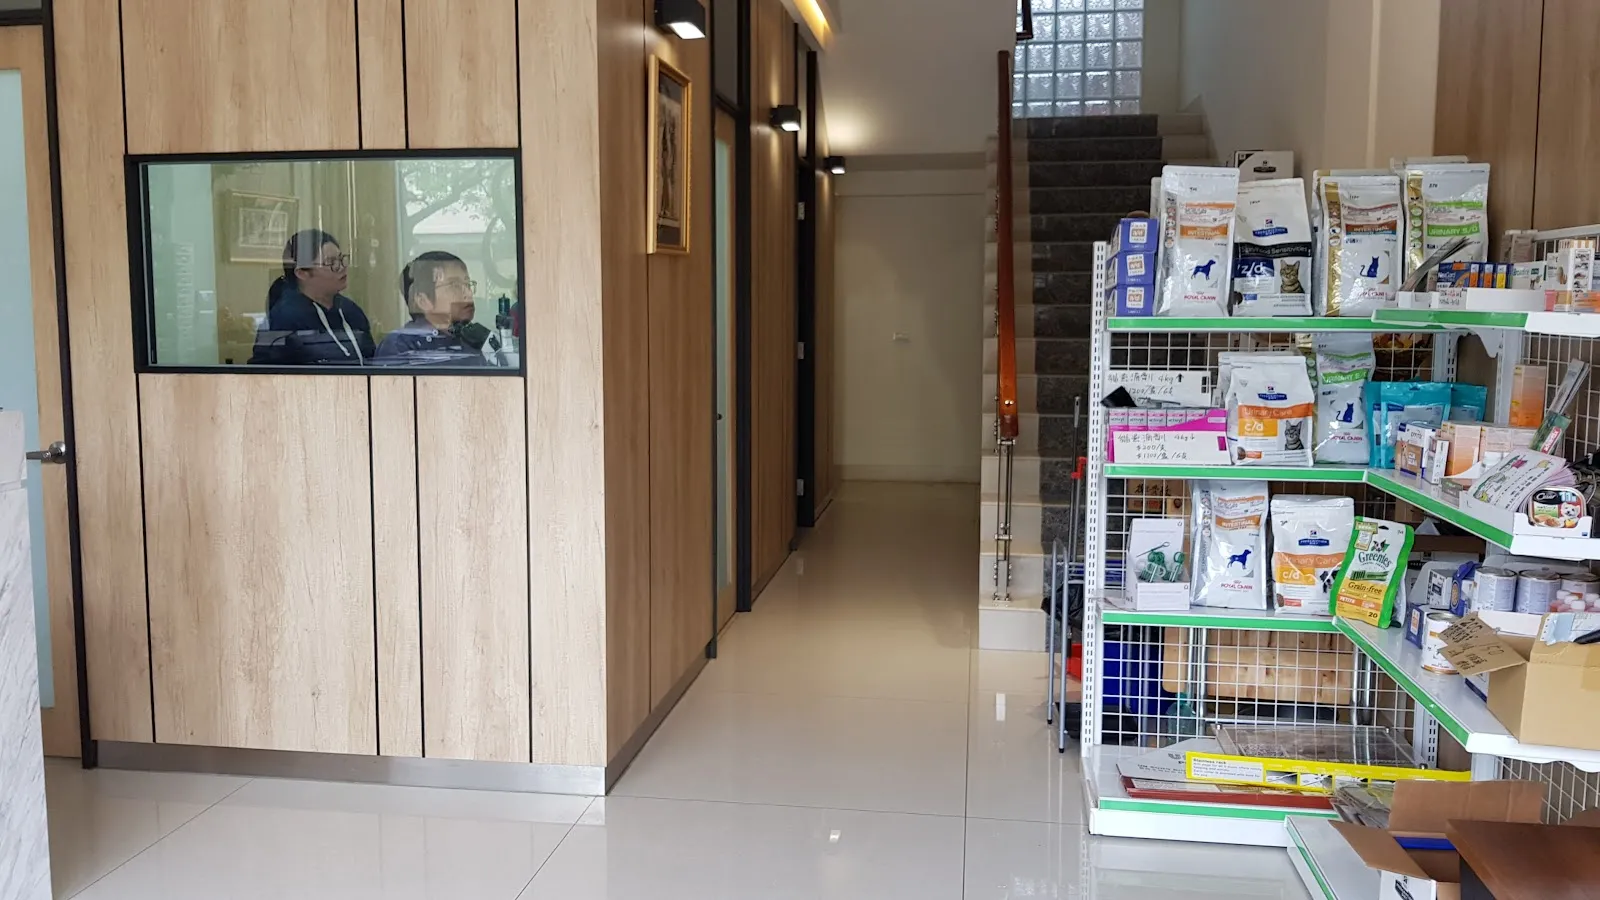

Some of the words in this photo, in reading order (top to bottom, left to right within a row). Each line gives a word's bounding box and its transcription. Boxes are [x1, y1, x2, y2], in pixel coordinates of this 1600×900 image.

[1271, 246, 1308, 254] Sensitivities
[1241, 262, 1263, 275] z/d
[1243, 407, 1271, 417] Urinary
[1272, 408, 1293, 416] Care
[1244, 420, 1264, 432] c/d
[1315, 556, 1339, 564] Care
[1358, 551, 1393, 568] Greenies
[1282, 570, 1300, 579] c/d
